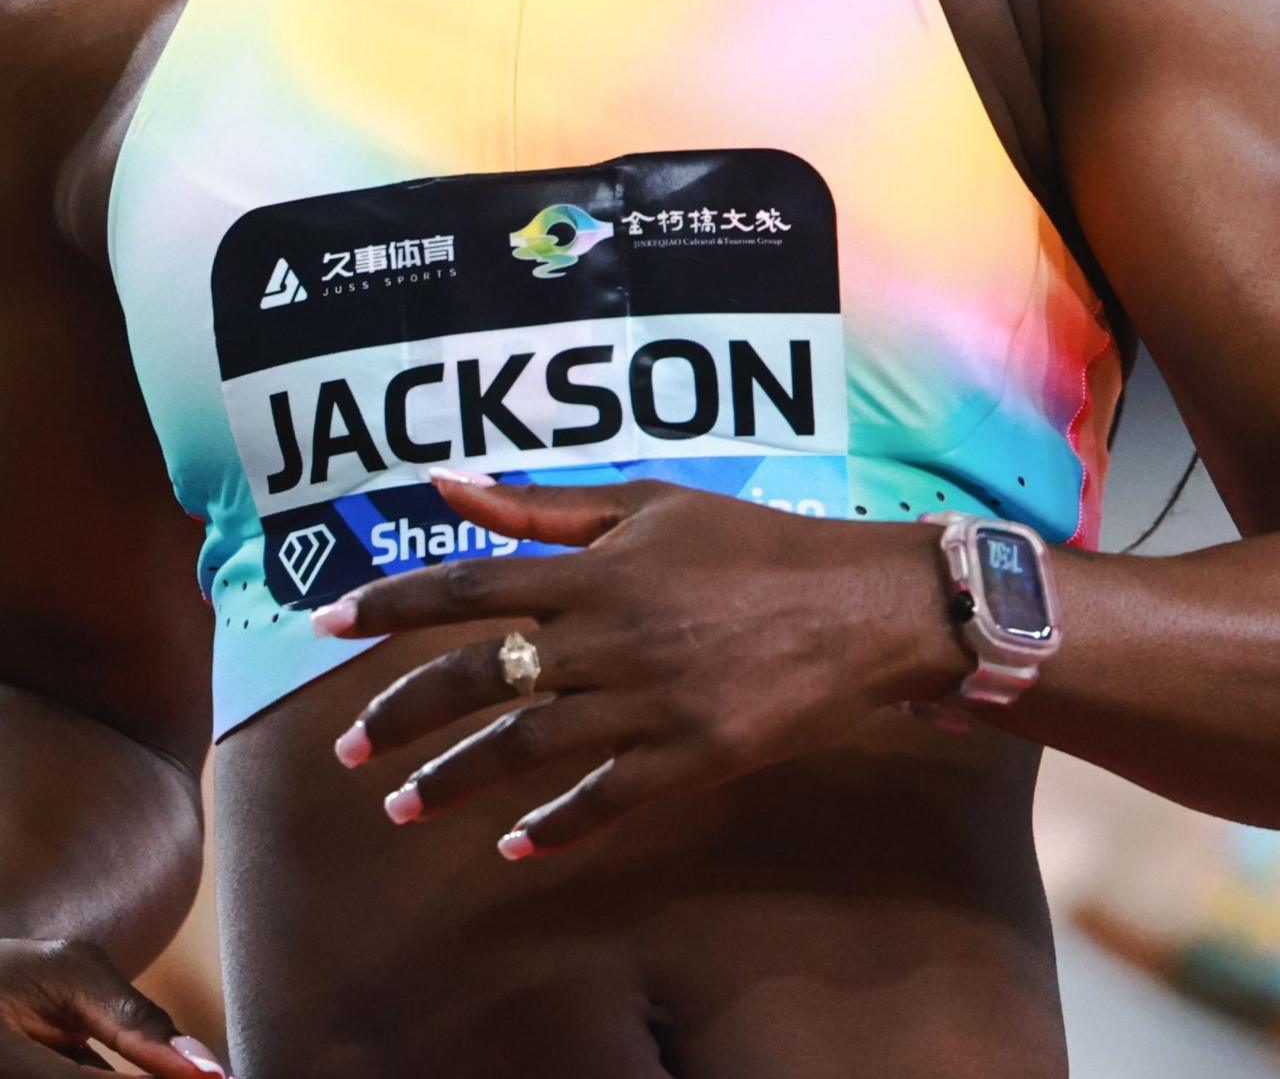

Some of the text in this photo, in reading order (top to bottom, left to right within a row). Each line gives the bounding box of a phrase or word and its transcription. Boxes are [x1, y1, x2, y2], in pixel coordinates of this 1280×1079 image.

[321, 235, 455, 281] 久事体育
[322, 267, 457, 297] JUSS SPORTS
[266, 338, 817, 496] JACKSON
[370, 517, 532, 566] Shang
